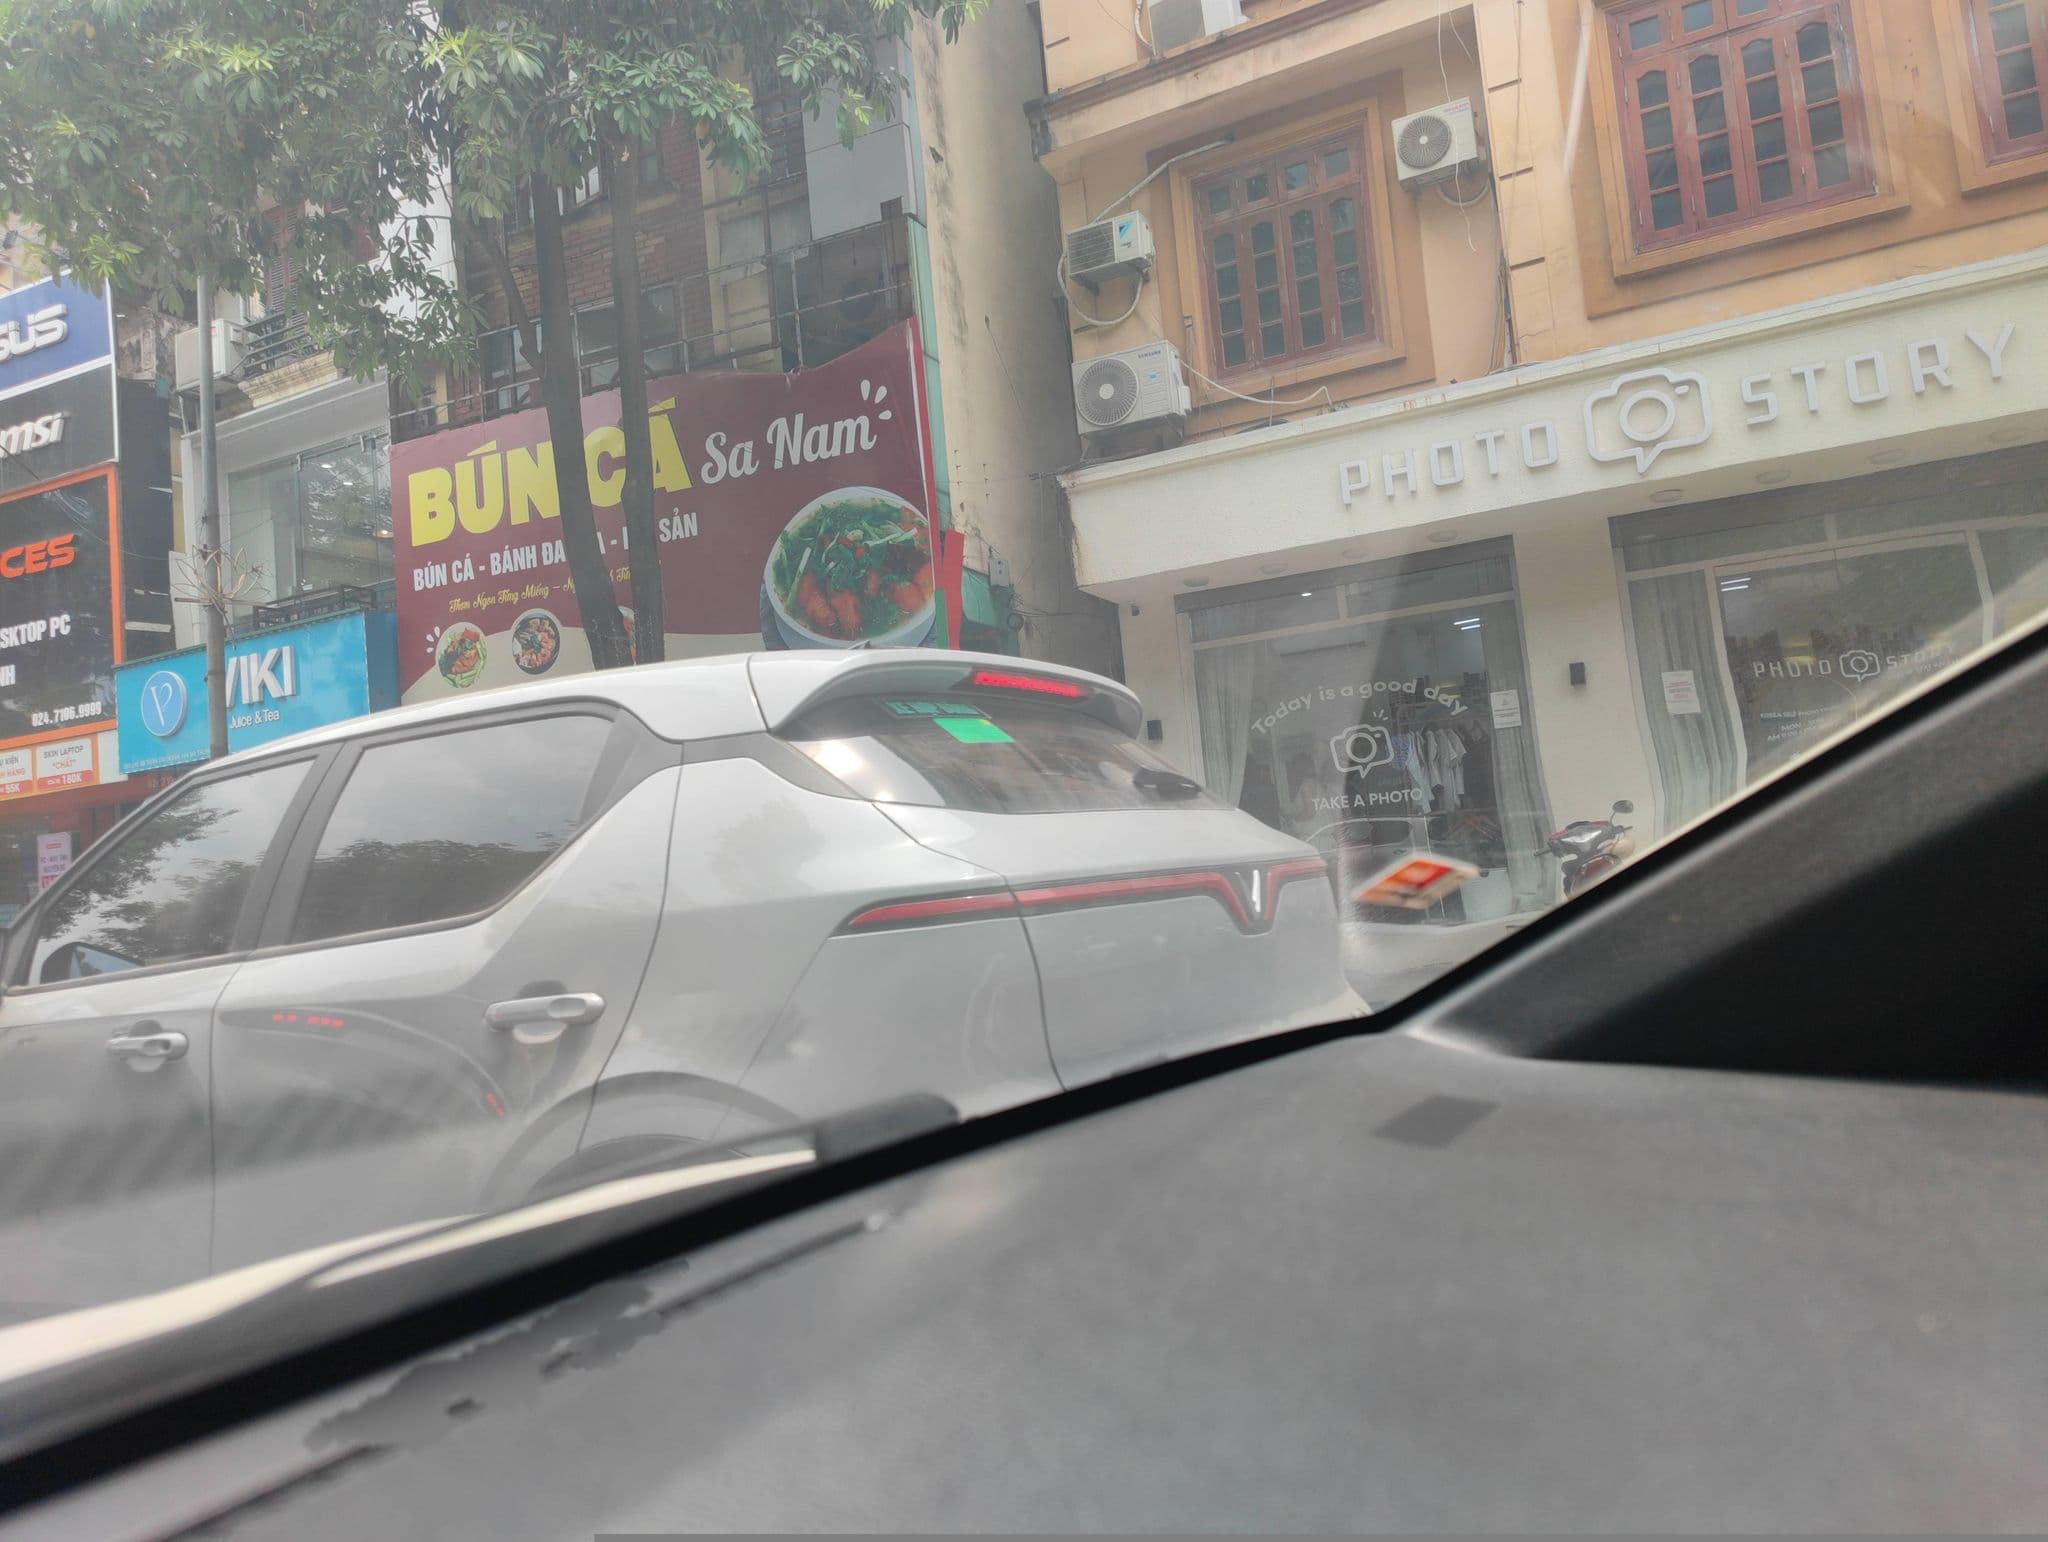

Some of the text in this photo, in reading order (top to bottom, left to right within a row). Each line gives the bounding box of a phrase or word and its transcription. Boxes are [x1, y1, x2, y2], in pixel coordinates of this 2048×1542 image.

[1337, 322, 2016, 505] PHOTO STORY
[408, 439, 561, 547] BÚN
[701, 431, 760, 484] Sa
[766, 413, 878, 470] Nam
[413, 561, 448, 592] BÚN
[451, 552, 475, 584] CÁ
[490, 544, 538, 576] BÁNH
[541, 539, 567, 566] ĐA
[658, 507, 698, 543] SẢN
[49, 614, 71, 637] PC
[1752, 659, 1832, 678] PHOTO
[254, 711, 262, 724] &
[263, 708, 280, 722] Tea
[1251, 692, 1314, 735] Today
[1319, 685, 1336, 701] is
[1340, 686, 1354, 697] a
[1359, 679, 1419, 699] good
[1424, 685, 1469, 716] day
[1312, 787, 1423, 811] TAKE A PHOTO
